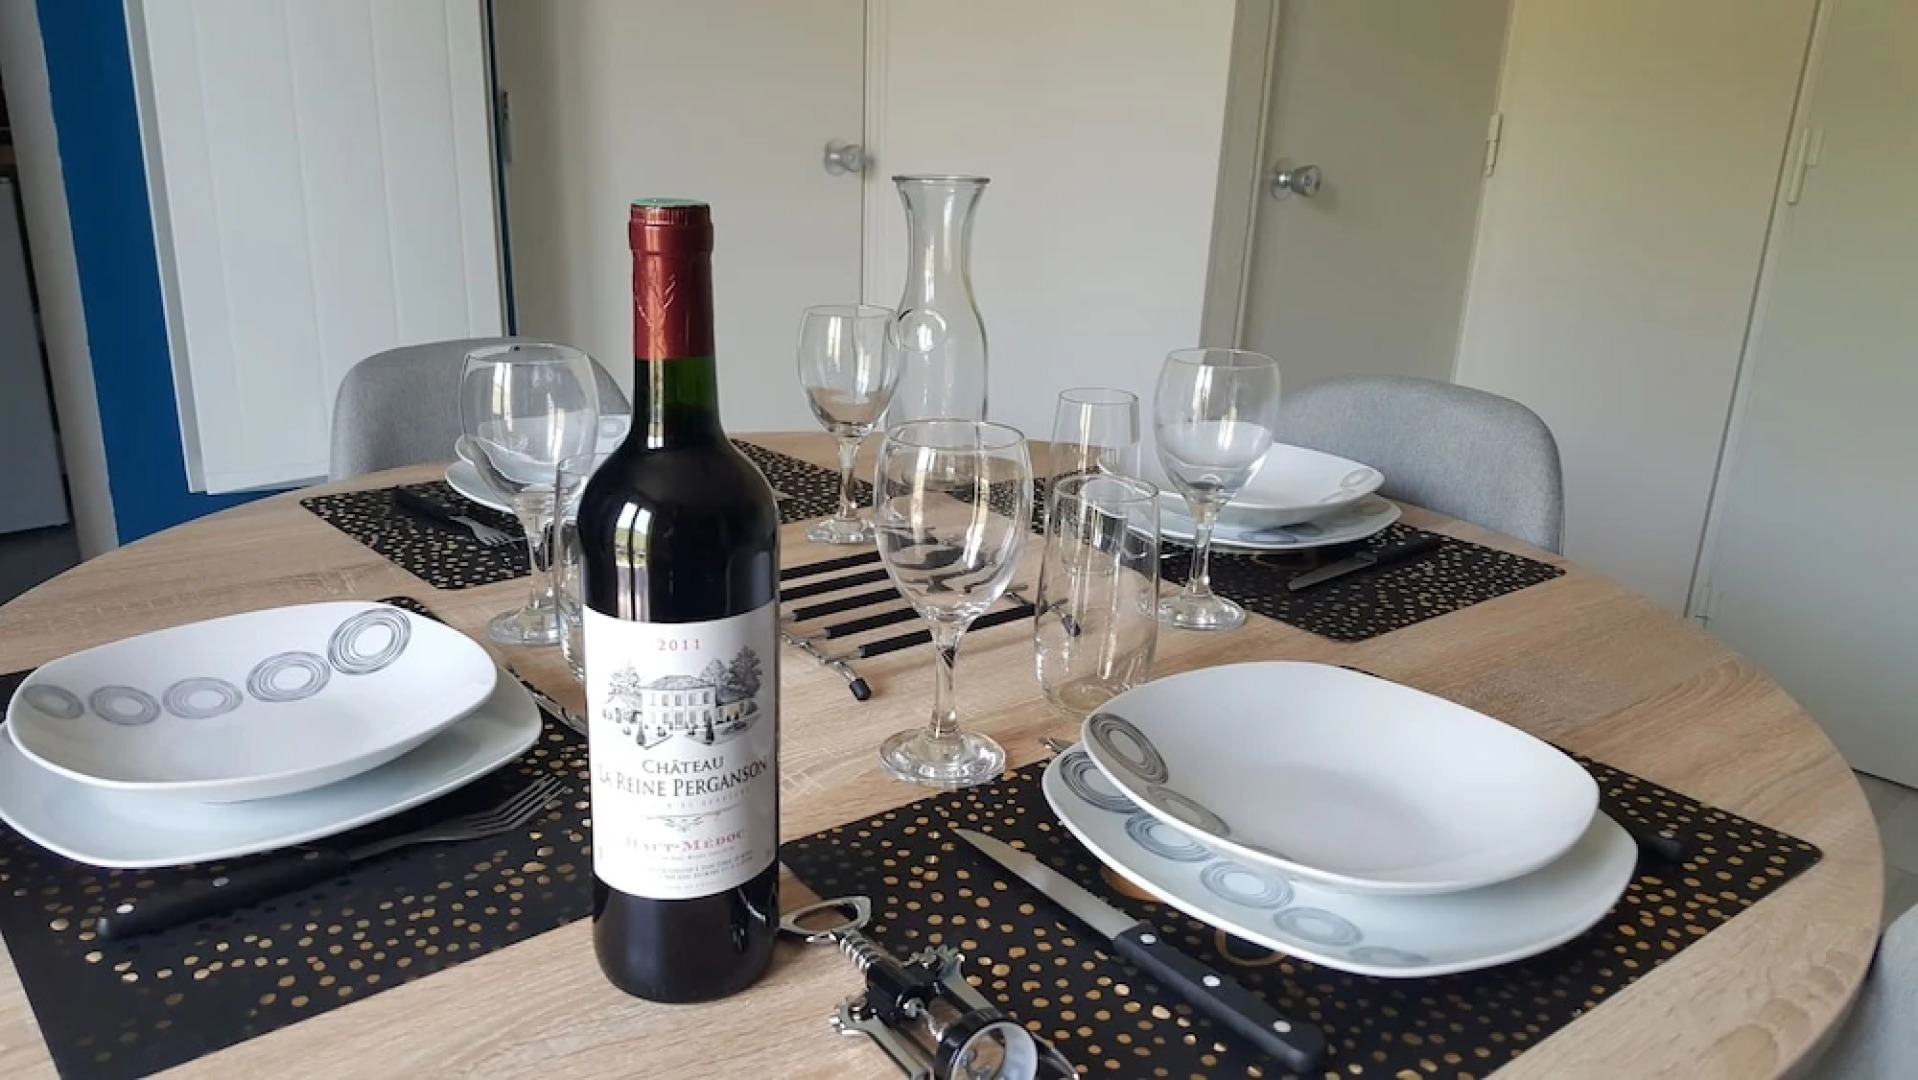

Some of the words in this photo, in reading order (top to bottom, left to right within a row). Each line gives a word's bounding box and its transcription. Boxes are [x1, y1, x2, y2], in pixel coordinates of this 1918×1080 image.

[658, 638, 701, 651] 2011
[642, 756, 724, 774] CHÂTEAU
[617, 772, 667, 797] REINE
[673, 758, 768, 797] PERGANSON
